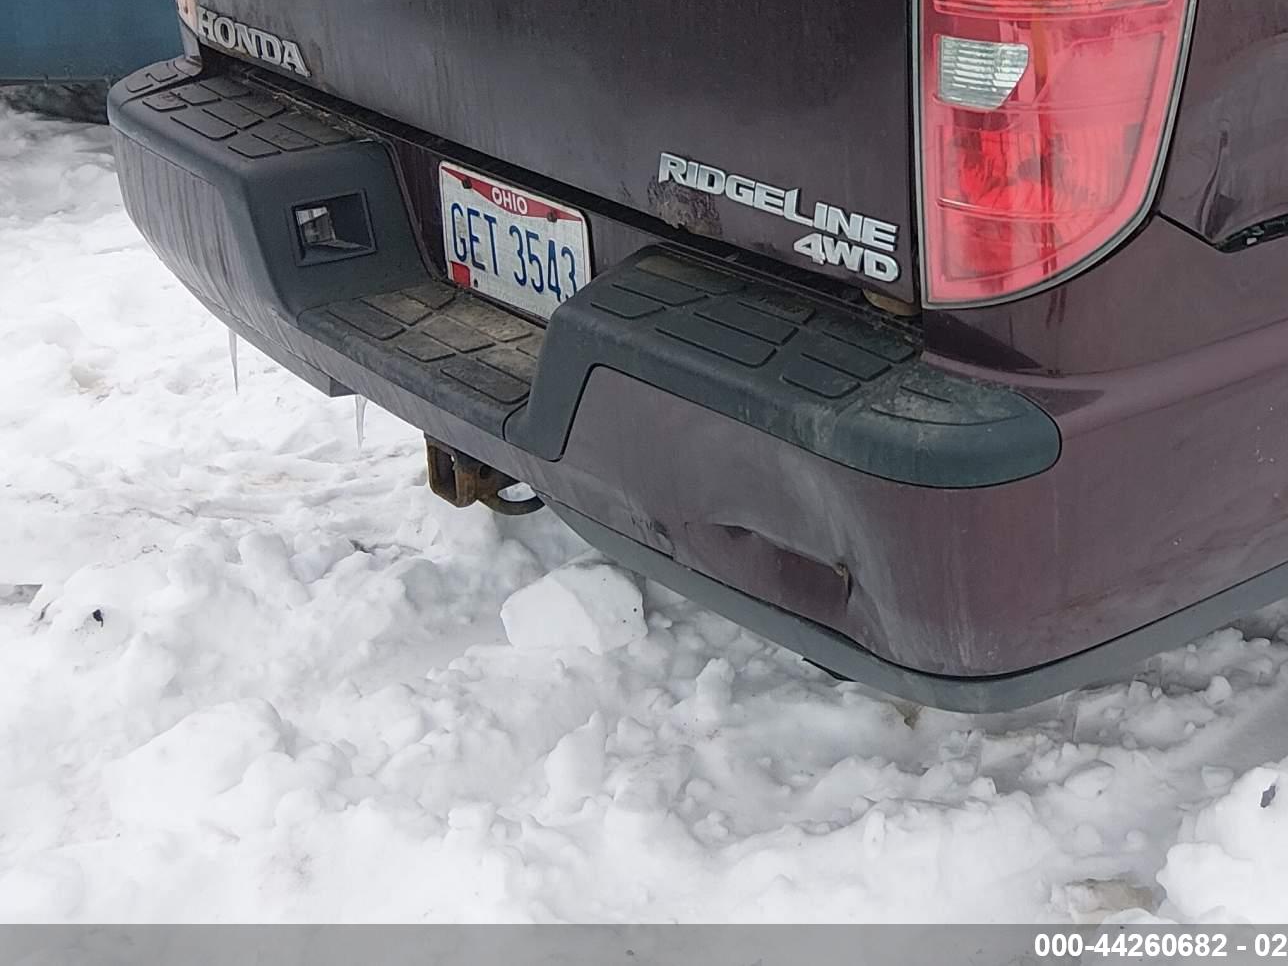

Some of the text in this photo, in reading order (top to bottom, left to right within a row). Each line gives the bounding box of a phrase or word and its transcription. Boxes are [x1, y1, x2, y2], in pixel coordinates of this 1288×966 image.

[198, 5, 312, 78] HONDA
[491, 187, 529, 215] OHIO
[658, 152, 898, 252] RIDGELINE
[451, 202, 578, 302] GET 3543
[793, 232, 900, 283] 4WD
